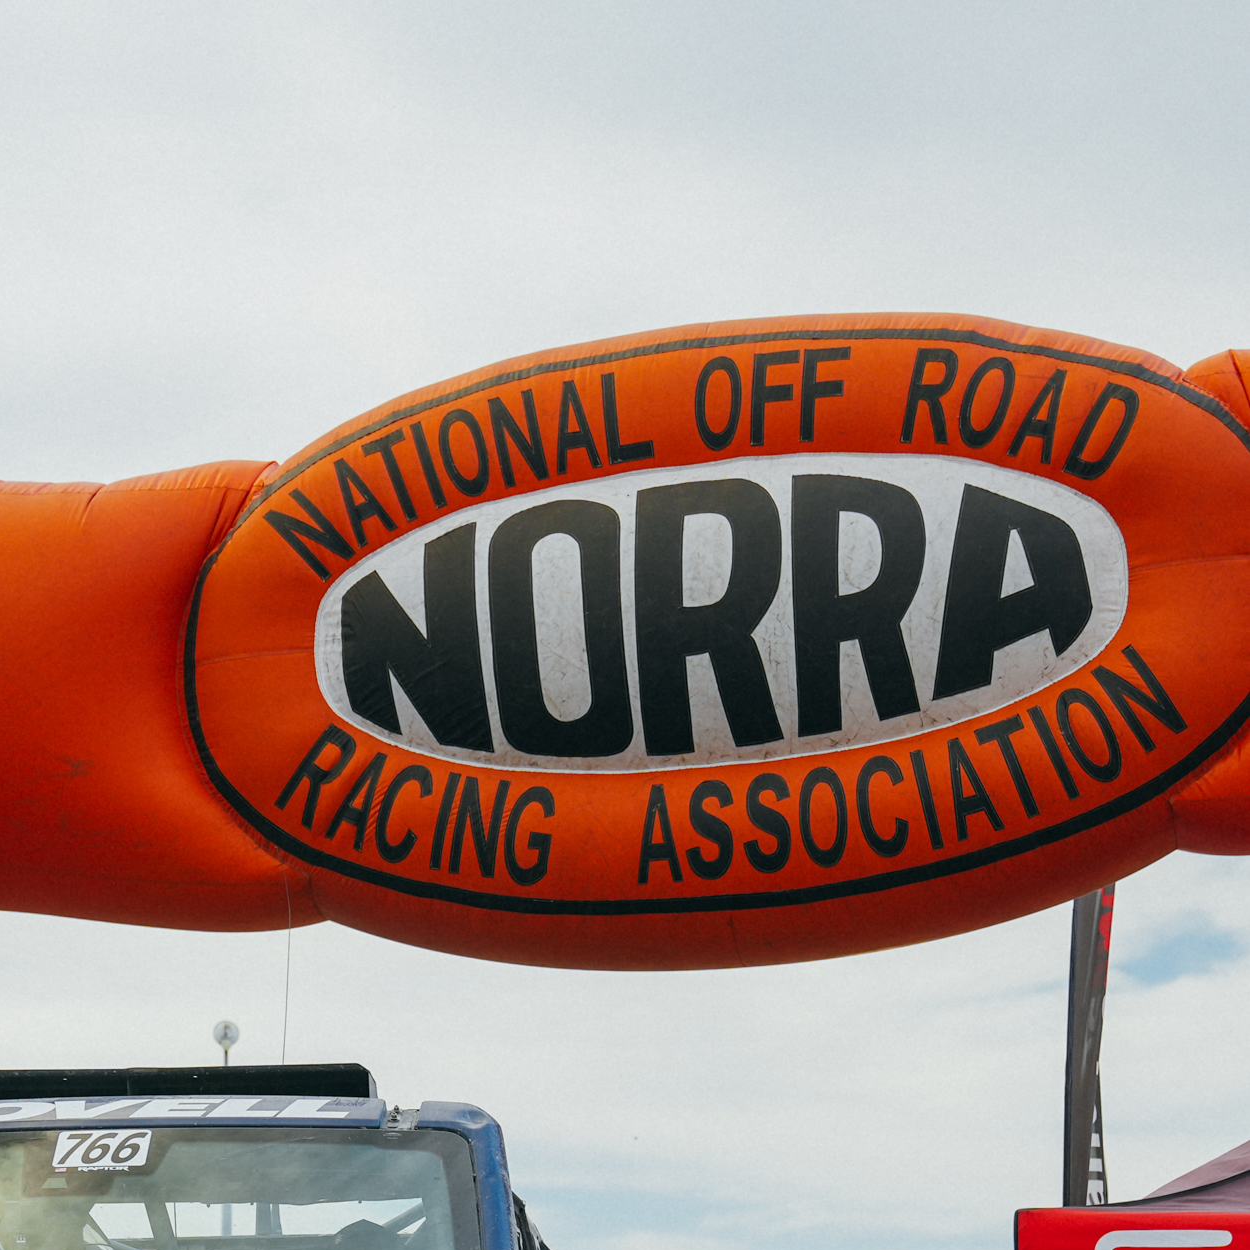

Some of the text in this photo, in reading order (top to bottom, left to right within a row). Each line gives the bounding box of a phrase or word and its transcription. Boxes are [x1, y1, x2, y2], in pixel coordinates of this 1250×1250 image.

[263, 346, 1140, 583] NATIONAL OFF ROAD
[340, 474, 1093, 758] NORRA
[274, 643, 1189, 886] RACING ASSOCIATION
[56, 1132, 149, 1165] 766
[77, 1165, 130, 1173] RAPTOR
